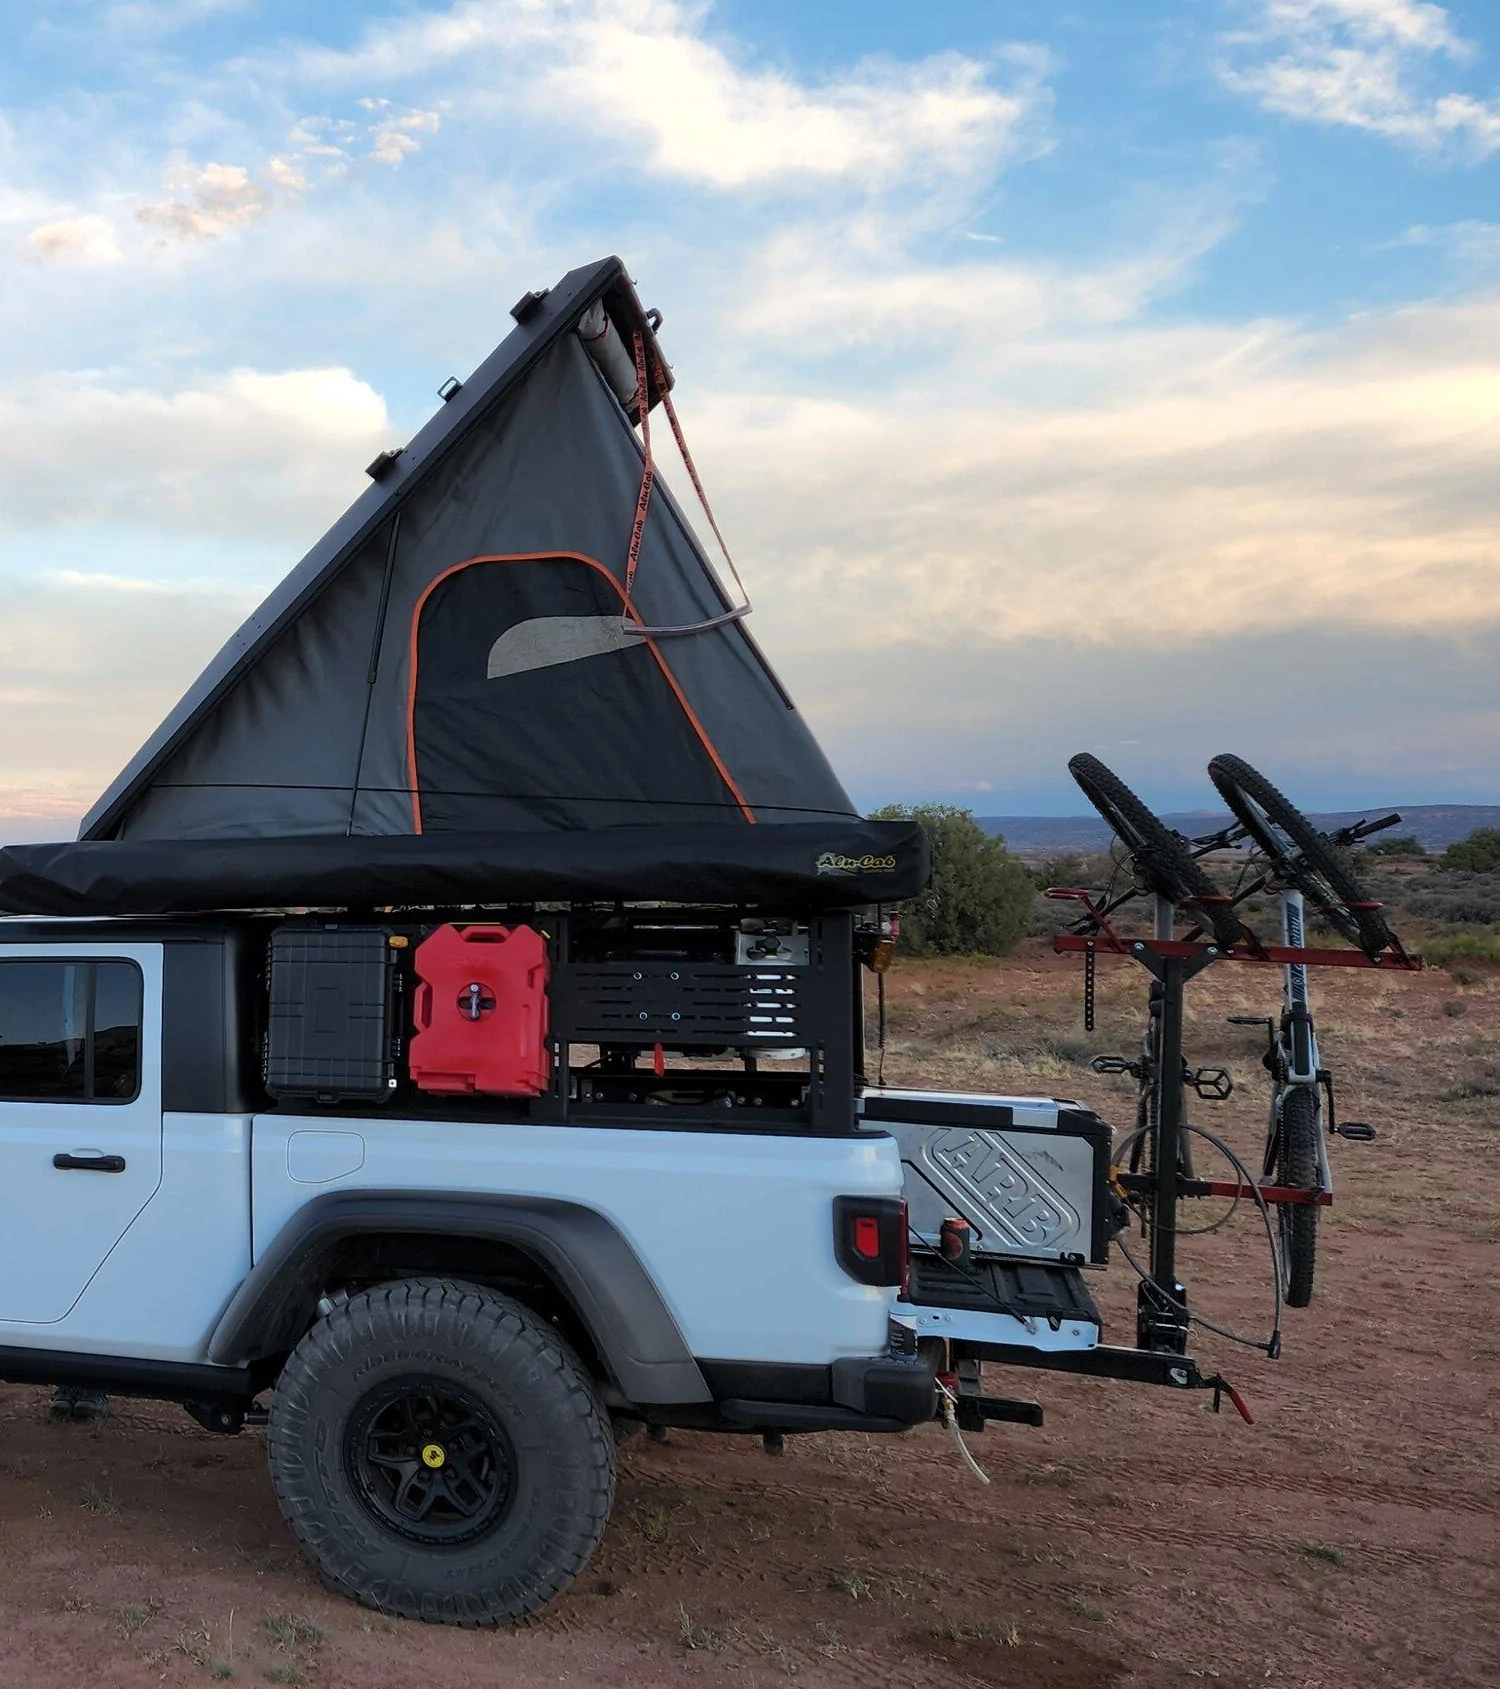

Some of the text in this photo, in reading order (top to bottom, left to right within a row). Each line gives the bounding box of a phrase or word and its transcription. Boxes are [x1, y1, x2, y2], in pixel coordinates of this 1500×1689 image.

[630, 519, 644, 561] Alu-Cab
[639, 470, 653, 511] Alu-Cab
[818, 853, 896, 869] Alu-Cab
[938, 1130, 1063, 1246] ARB
